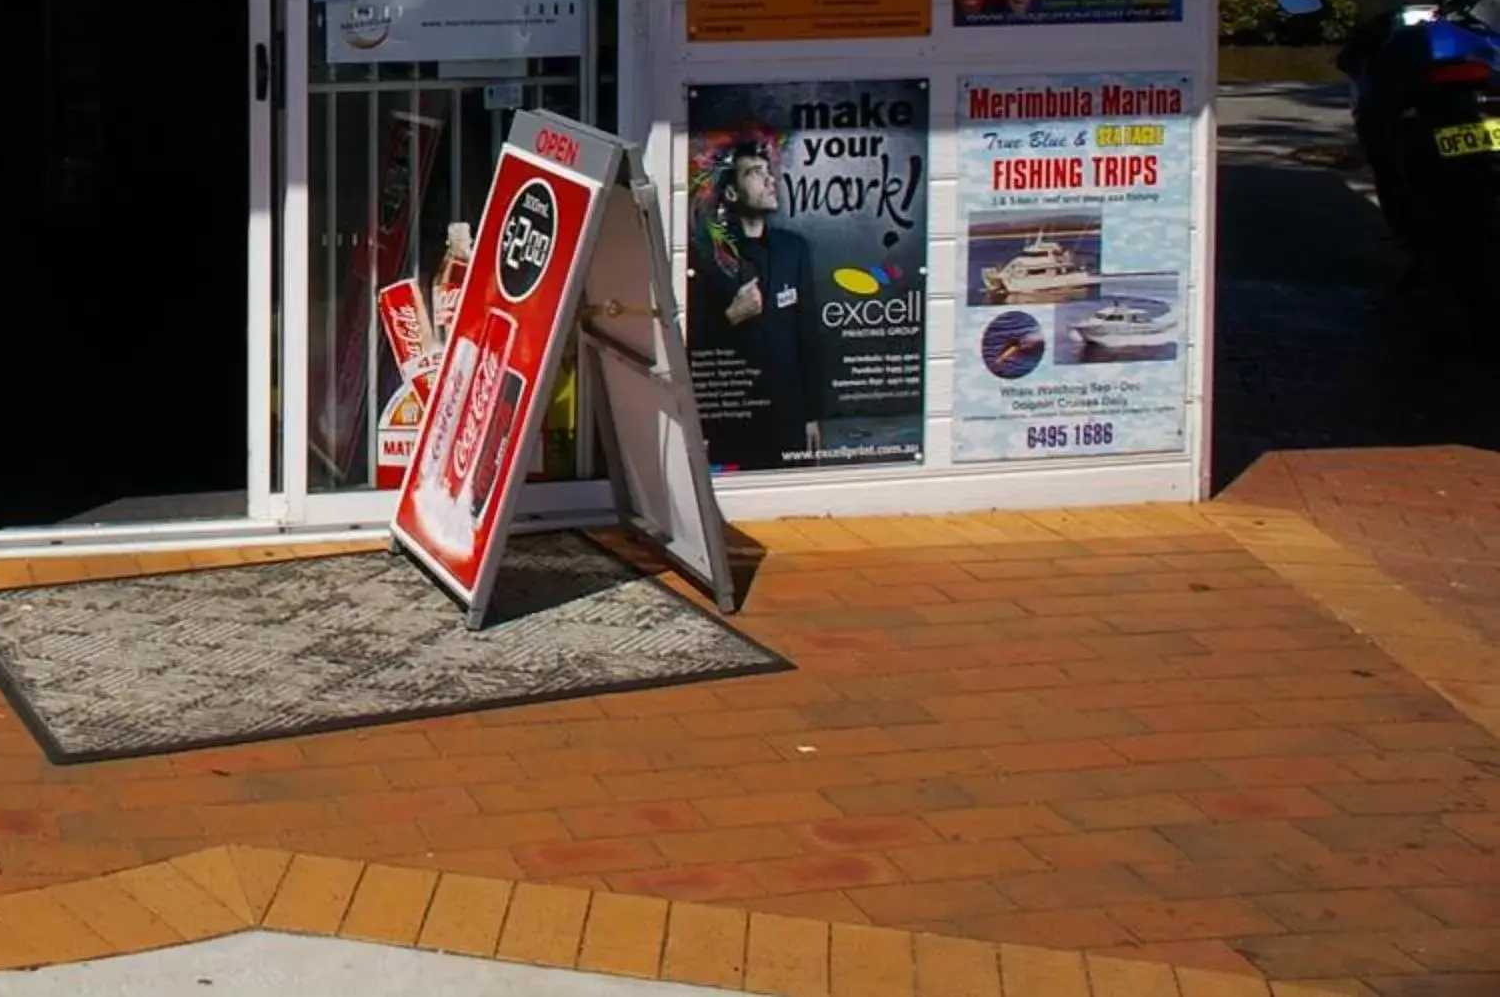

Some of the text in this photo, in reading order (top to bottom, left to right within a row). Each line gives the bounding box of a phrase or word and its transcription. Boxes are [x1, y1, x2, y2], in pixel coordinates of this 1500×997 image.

[791, 92, 914, 130] make
[970, 84, 1182, 120] Merimbula Marina
[534, 128, 580, 166] OPEN
[803, 134, 884, 165] your
[983, 128, 1090, 150] True Blue &
[993, 155, 1158, 190] FISHING TRIPS
[783, 153, 922, 248] mark!
[502, 216, 550, 271] $2.00
[821, 290, 922, 328] excell
[1027, 423, 1114, 449] 6495 1686
